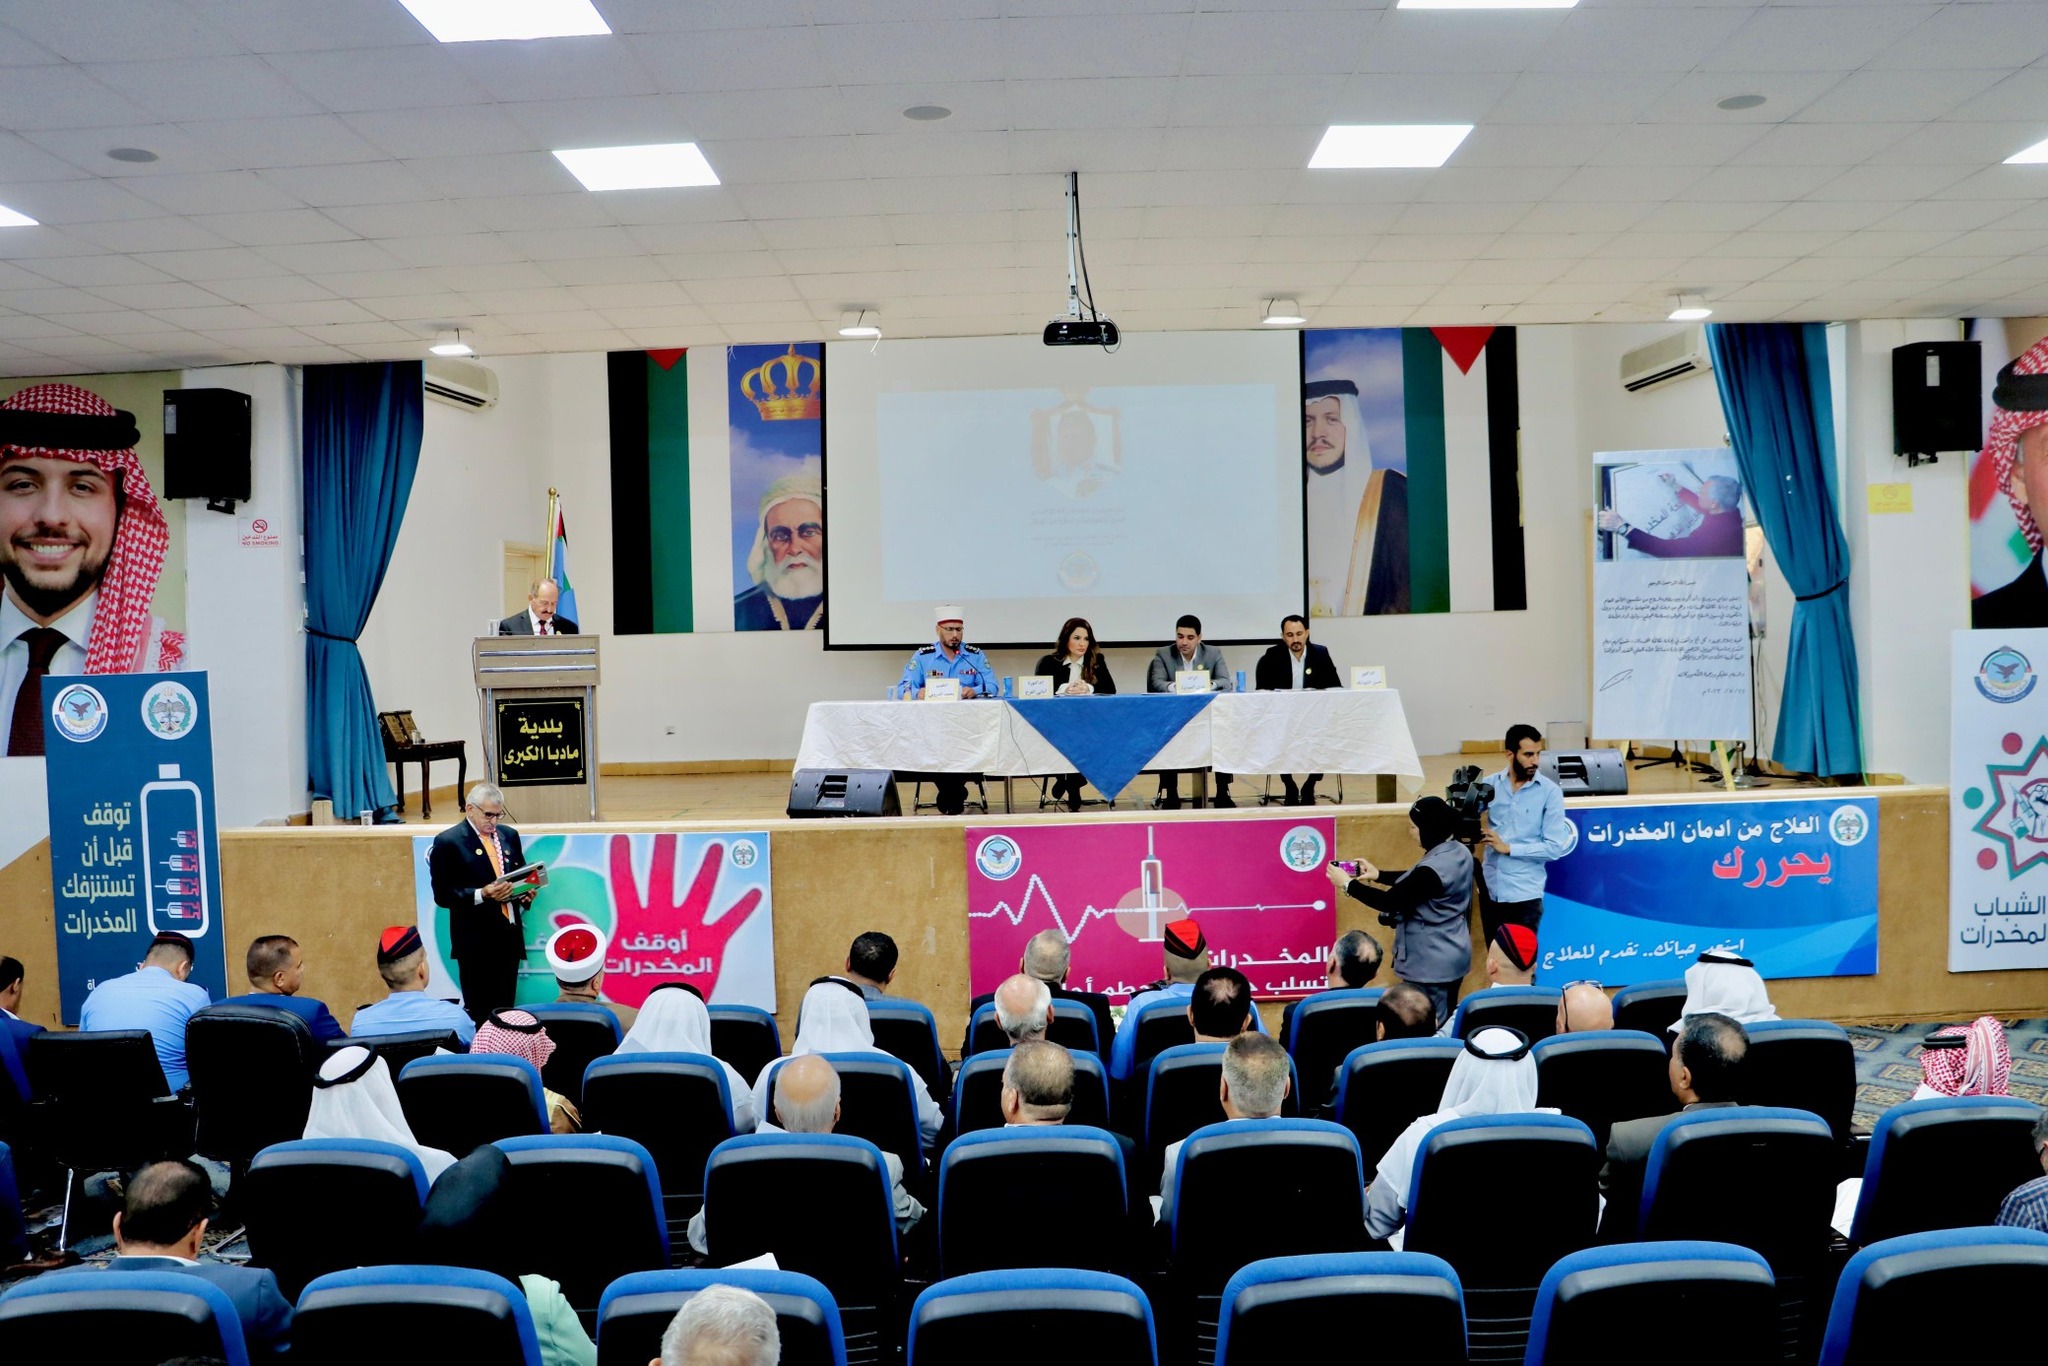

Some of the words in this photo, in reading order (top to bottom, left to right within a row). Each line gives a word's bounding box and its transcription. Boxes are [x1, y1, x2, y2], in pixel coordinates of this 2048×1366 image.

[518, 717, 563, 739] بلدية
[504, 745, 544, 767] الكبرى
[547, 744, 579, 765] مادبا
[83, 801, 132, 832] توقف
[1769, 815, 1820, 843] العلاج
[1587, 820, 1675, 847] المخدرات
[1681, 818, 1731, 843] ادمان
[1737, 821, 1763, 842] من
[81, 835, 99, 867] أن
[103, 836, 133, 867] قبل
[1712, 846, 1832, 888] يحررك
[62, 872, 136, 904] تستنزفك
[1974, 891, 2046, 923] الشباب
[64, 908, 137, 940] المخدرات
[1960, 923, 2047, 948] لمخدرات
[621, 930, 688, 954] أوقف
[1599, 942, 1640, 965] تقدم
[603, 957, 712, 976] المخدرات
[1542, 944, 1595, 970] للعلاج
